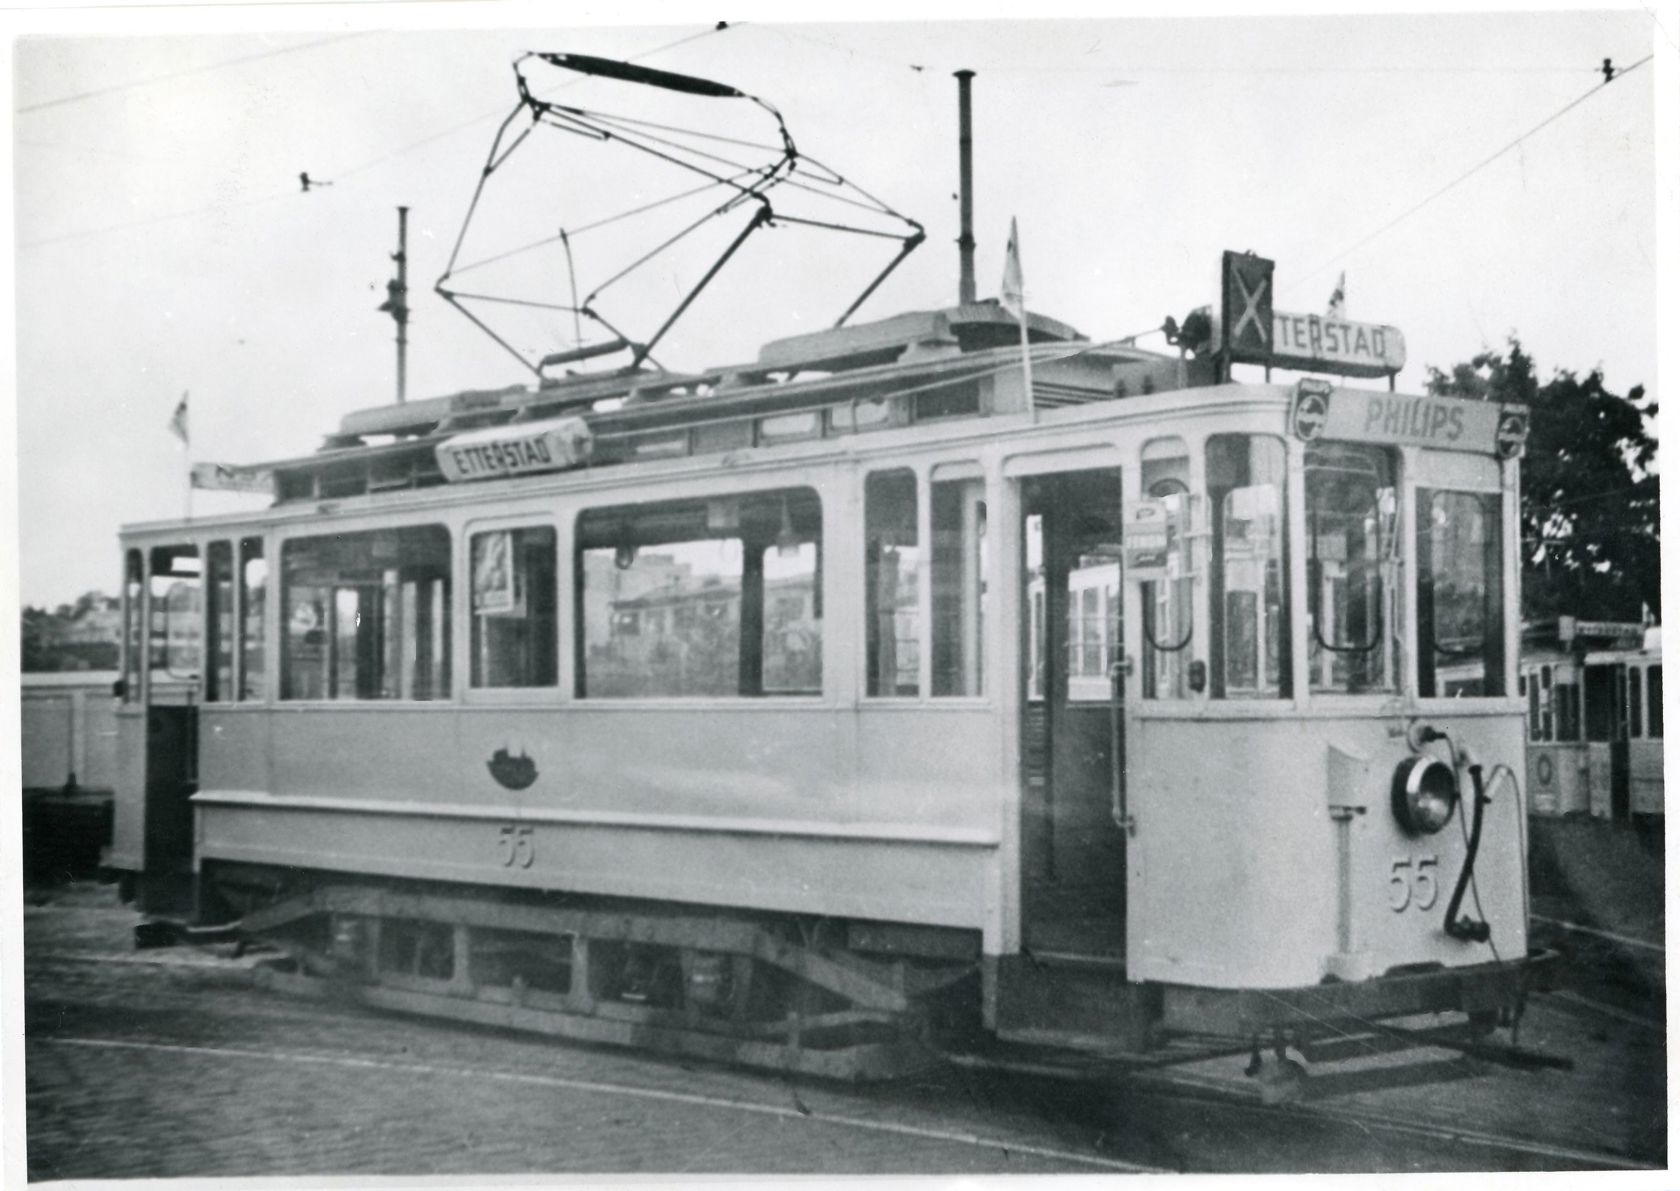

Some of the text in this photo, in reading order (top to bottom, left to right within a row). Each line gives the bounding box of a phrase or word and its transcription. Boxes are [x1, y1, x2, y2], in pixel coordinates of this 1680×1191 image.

[1273, 314, 1386, 359] TERSTAD
[1365, 397, 1465, 442] PHILIPS
[453, 438, 551, 474] ETTERSTAD
[499, 825, 535, 869] 55
[1389, 855, 1438, 914] 55
